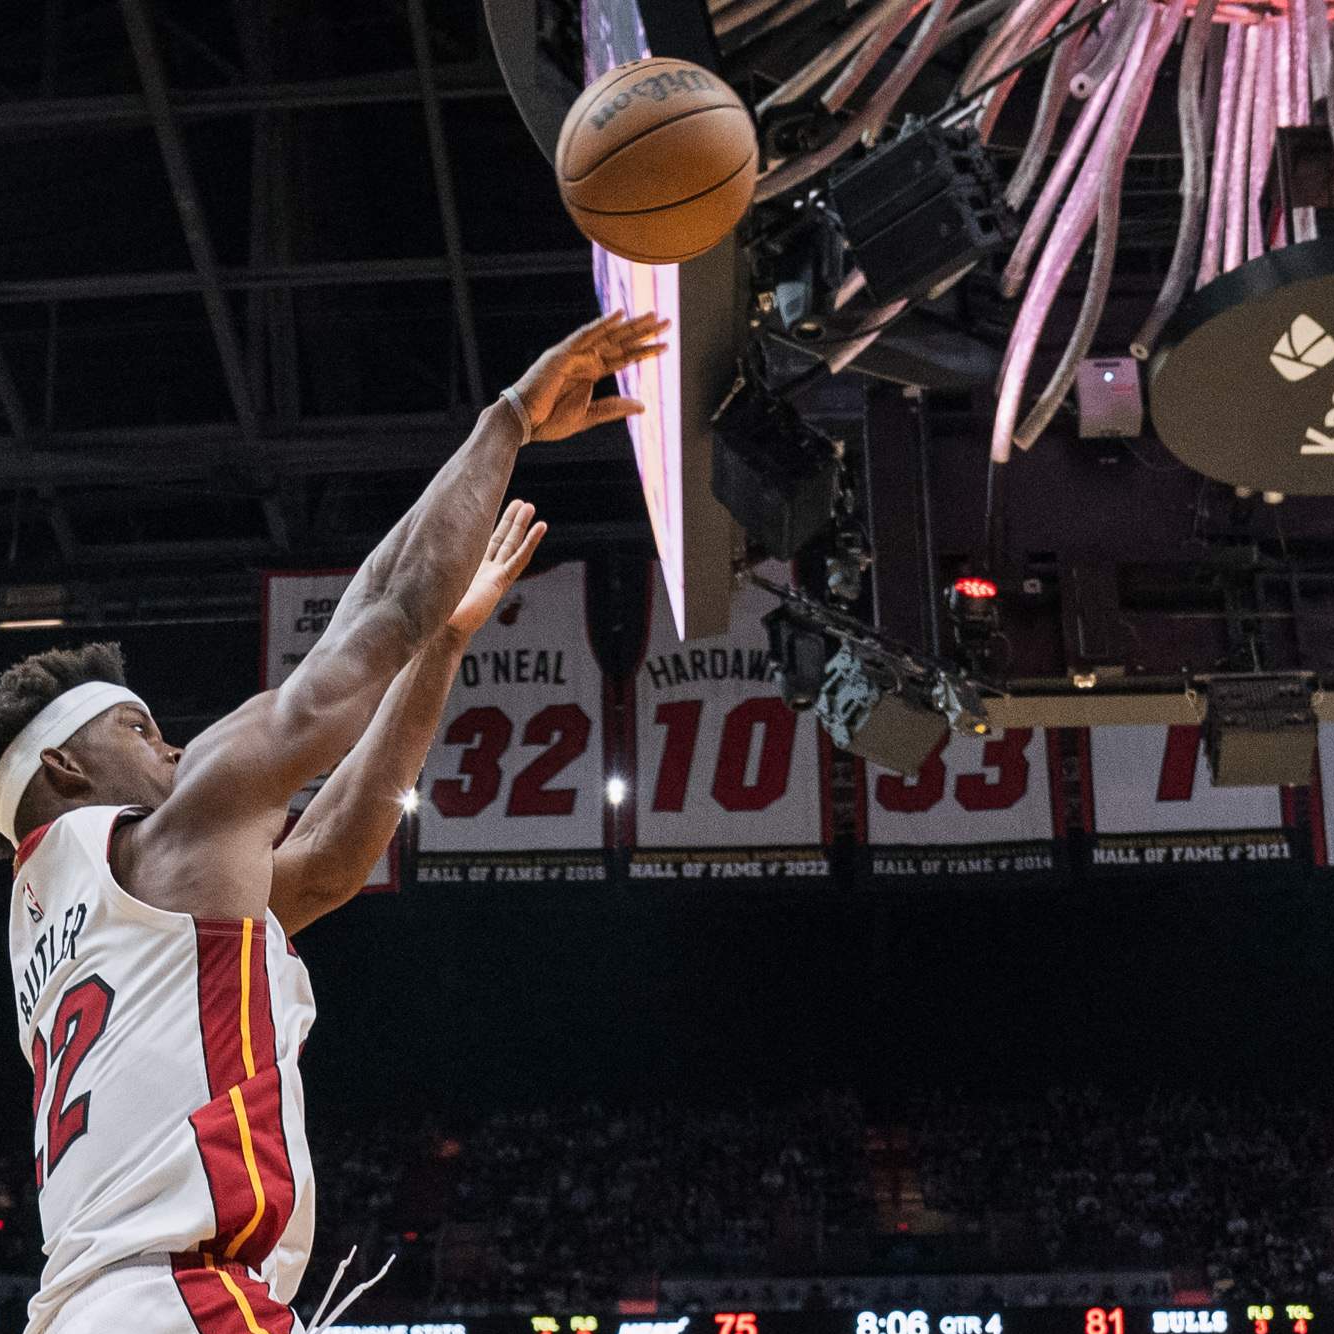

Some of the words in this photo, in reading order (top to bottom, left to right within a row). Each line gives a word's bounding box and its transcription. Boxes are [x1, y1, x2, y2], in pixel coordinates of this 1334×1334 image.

[430, 703, 592, 818] 32
[652, 697, 799, 813] 10
[1092, 848, 1139, 865] HALL
[1144, 847, 1167, 864] OF
[1170, 846, 1225, 863] FAME
[1245, 843, 1291, 860] 2021
[416, 867, 463, 882] HALL
[468, 866, 492, 882] OF
[495, 866, 545, 882] FAME
[629, 863, 678, 879] HALL
[681, 863, 706, 878] OF
[710, 862, 763, 878] FAME
[784, 861, 830, 877] 2022
[873, 858, 917, 875] HALL
[921, 858, 943, 874] OF
[947, 857, 994, 874] FAME
[19, 902, 88, 1026] BUTLER
[1152, 1310, 1228, 1334] BULLS
